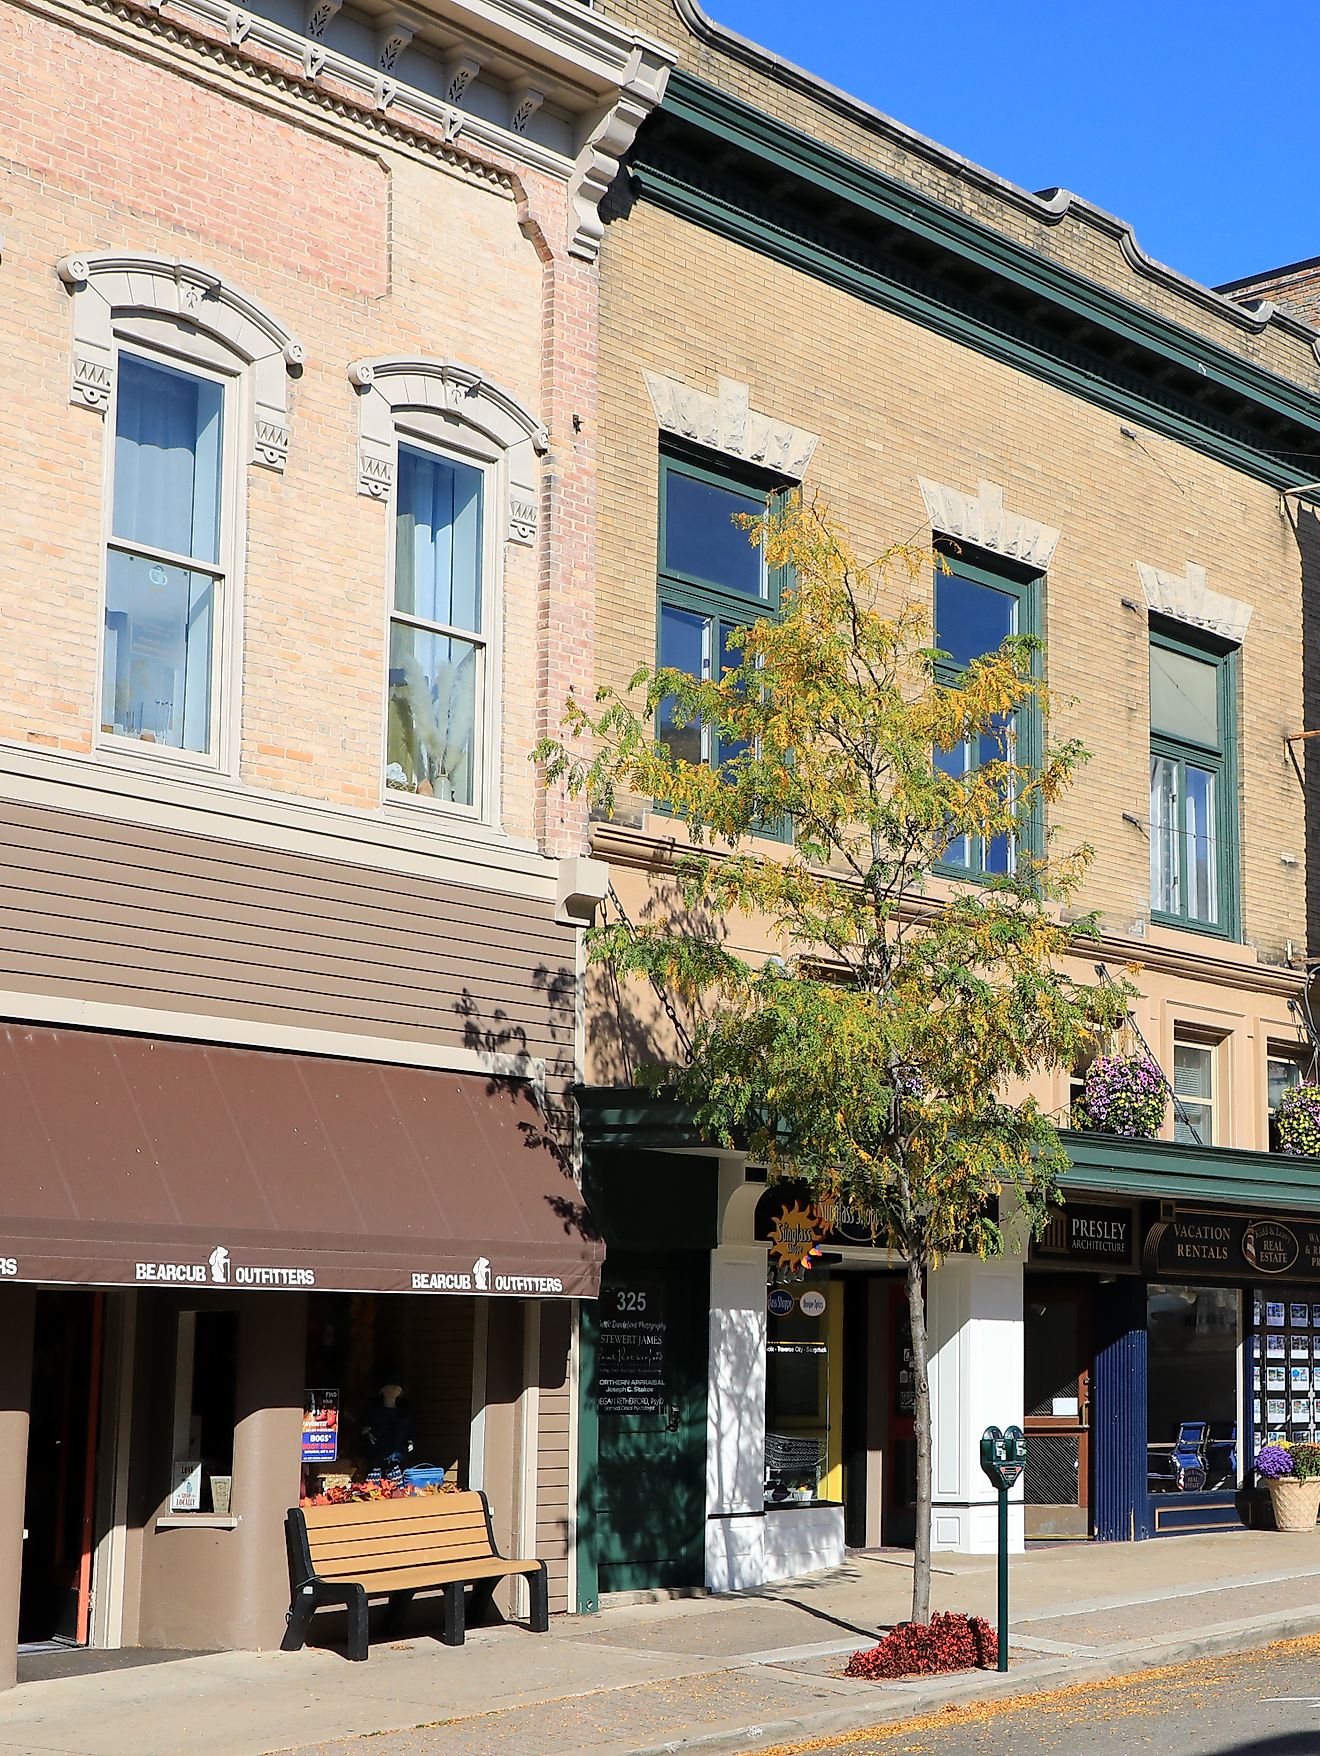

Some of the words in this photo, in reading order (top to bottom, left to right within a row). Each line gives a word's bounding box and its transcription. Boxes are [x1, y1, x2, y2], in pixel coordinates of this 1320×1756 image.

[777, 1223, 812, 1243] Sunglass
[1072, 1218, 1127, 1240] PRESLEY
[1173, 1223, 1231, 1240] VACATION
[1071, 1239, 1125, 1253] ARCHITECTURE
[1177, 1244, 1228, 1260] RENTALS
[1263, 1240, 1284, 1252] REAL
[1305, 1245, 1311, 1255] &
[1260, 1251, 1288, 1263] ESTATE
[135, 1262, 207, 1283] BEARCUB
[235, 1267, 315, 1286] OUTFITTERS
[411, 1273, 471, 1291] BEARCUB
[495, 1276, 562, 1293] OUTFITTERS
[616, 1291, 647, 1311] 325
[600, 1335, 637, 1345] STEWERT
[638, 1335, 663, 1347] JAMES
[795, 1346, 804, 1354] City
